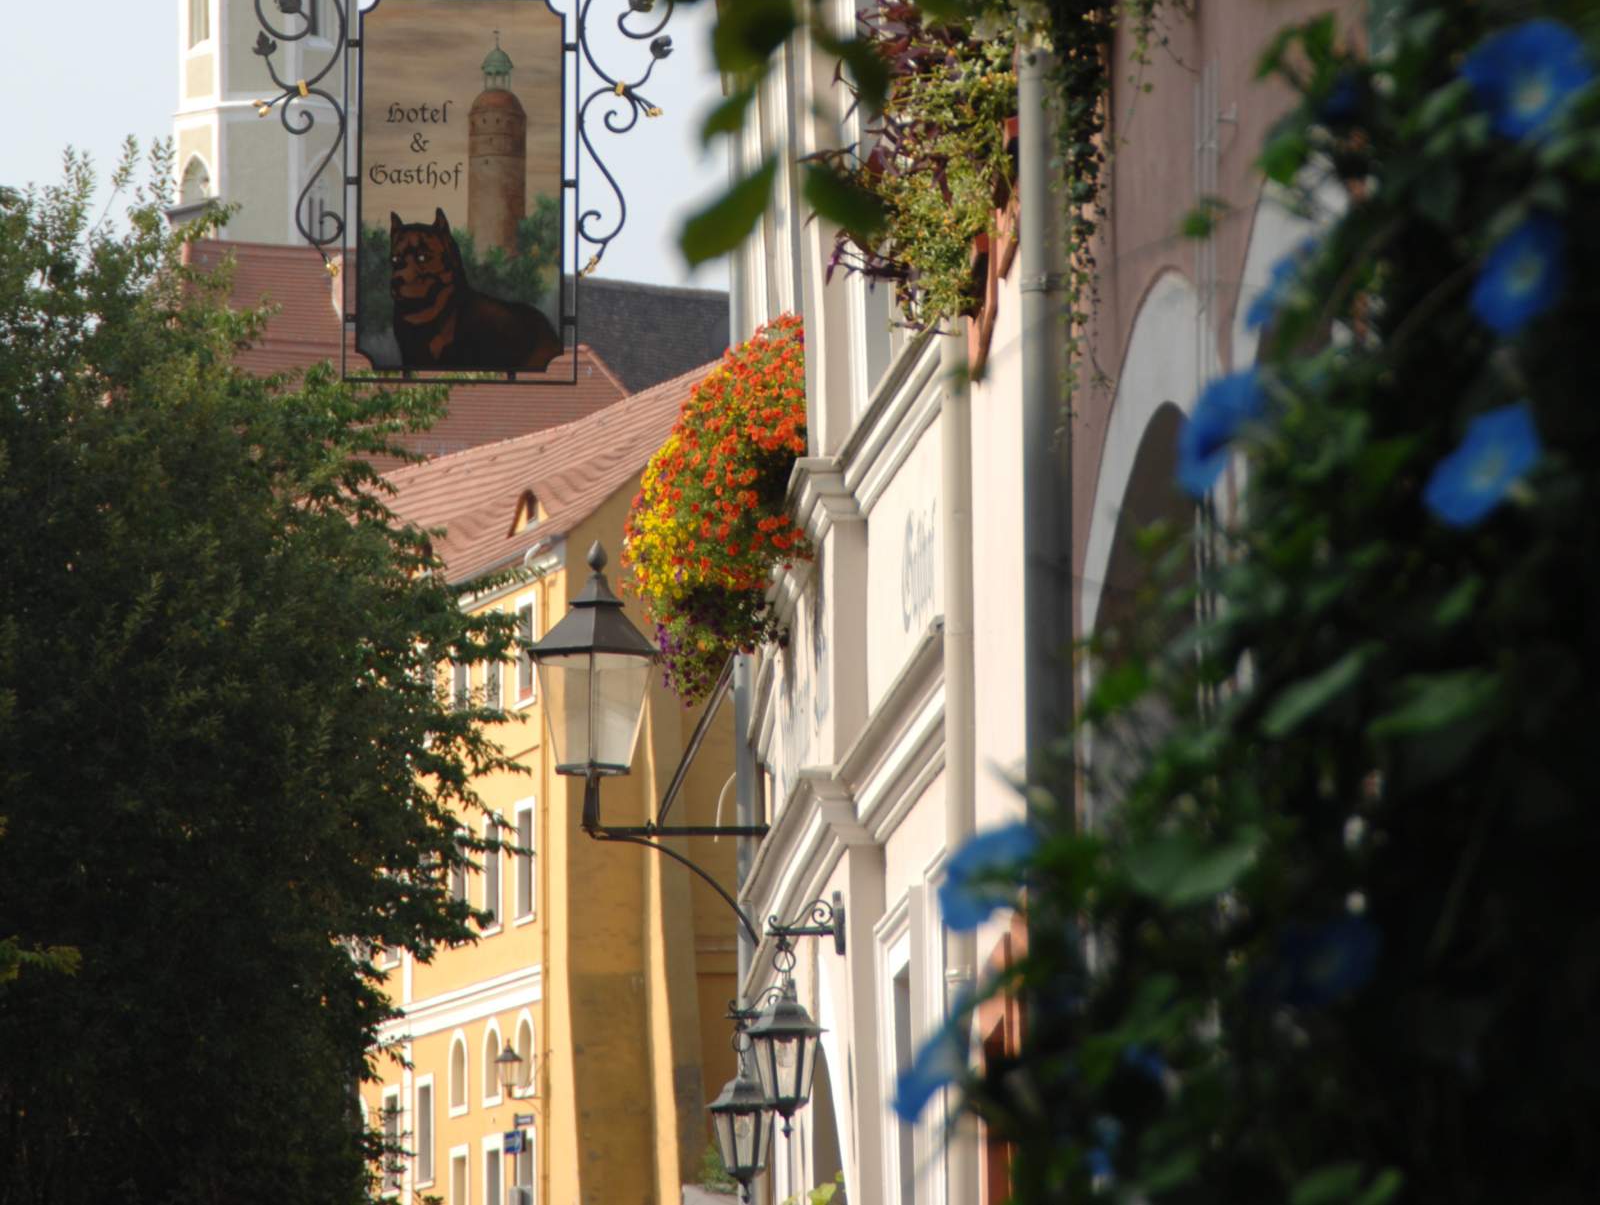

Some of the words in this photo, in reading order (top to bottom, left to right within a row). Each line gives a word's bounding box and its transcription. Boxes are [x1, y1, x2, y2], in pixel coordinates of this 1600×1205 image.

[386, 100, 453, 124] Hotel
[409, 132, 430, 153] &
[369, 161, 463, 189] Gasthof
